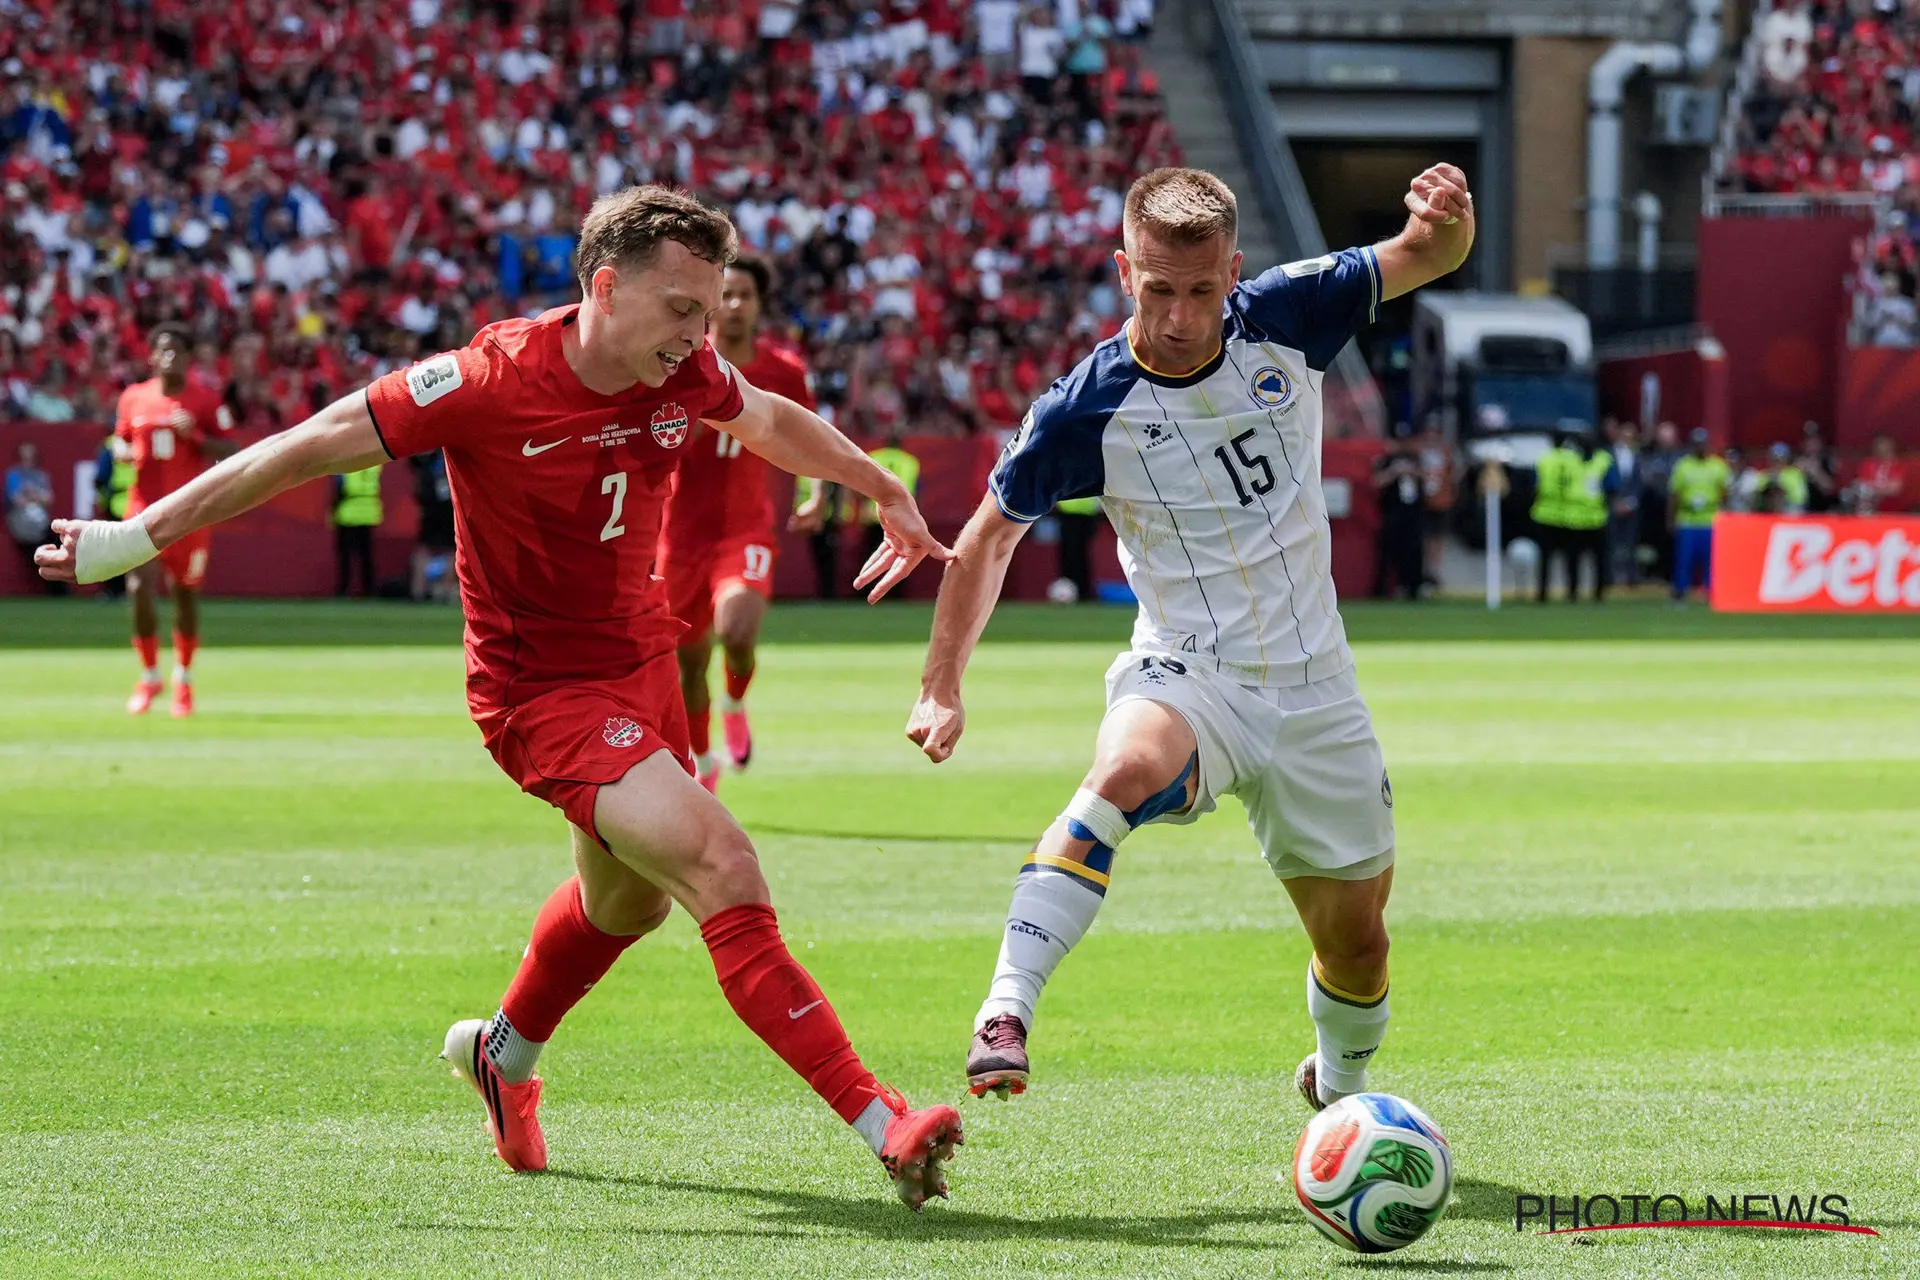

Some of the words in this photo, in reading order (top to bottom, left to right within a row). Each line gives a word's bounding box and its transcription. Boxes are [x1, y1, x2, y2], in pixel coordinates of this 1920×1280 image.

[601, 423, 620, 432] CANADA
[652, 419, 687, 433] CANADA
[581, 435, 600, 443] BOSNIA
[600, 432, 610, 440] AND
[1145, 432, 1174, 450] KELME
[1214, 428, 1278, 508] 15
[600, 471, 628, 543] 2
[743, 544, 772, 580] 17
[608, 722, 637, 744] CANADA
[1010, 924, 1050, 943] KELME
